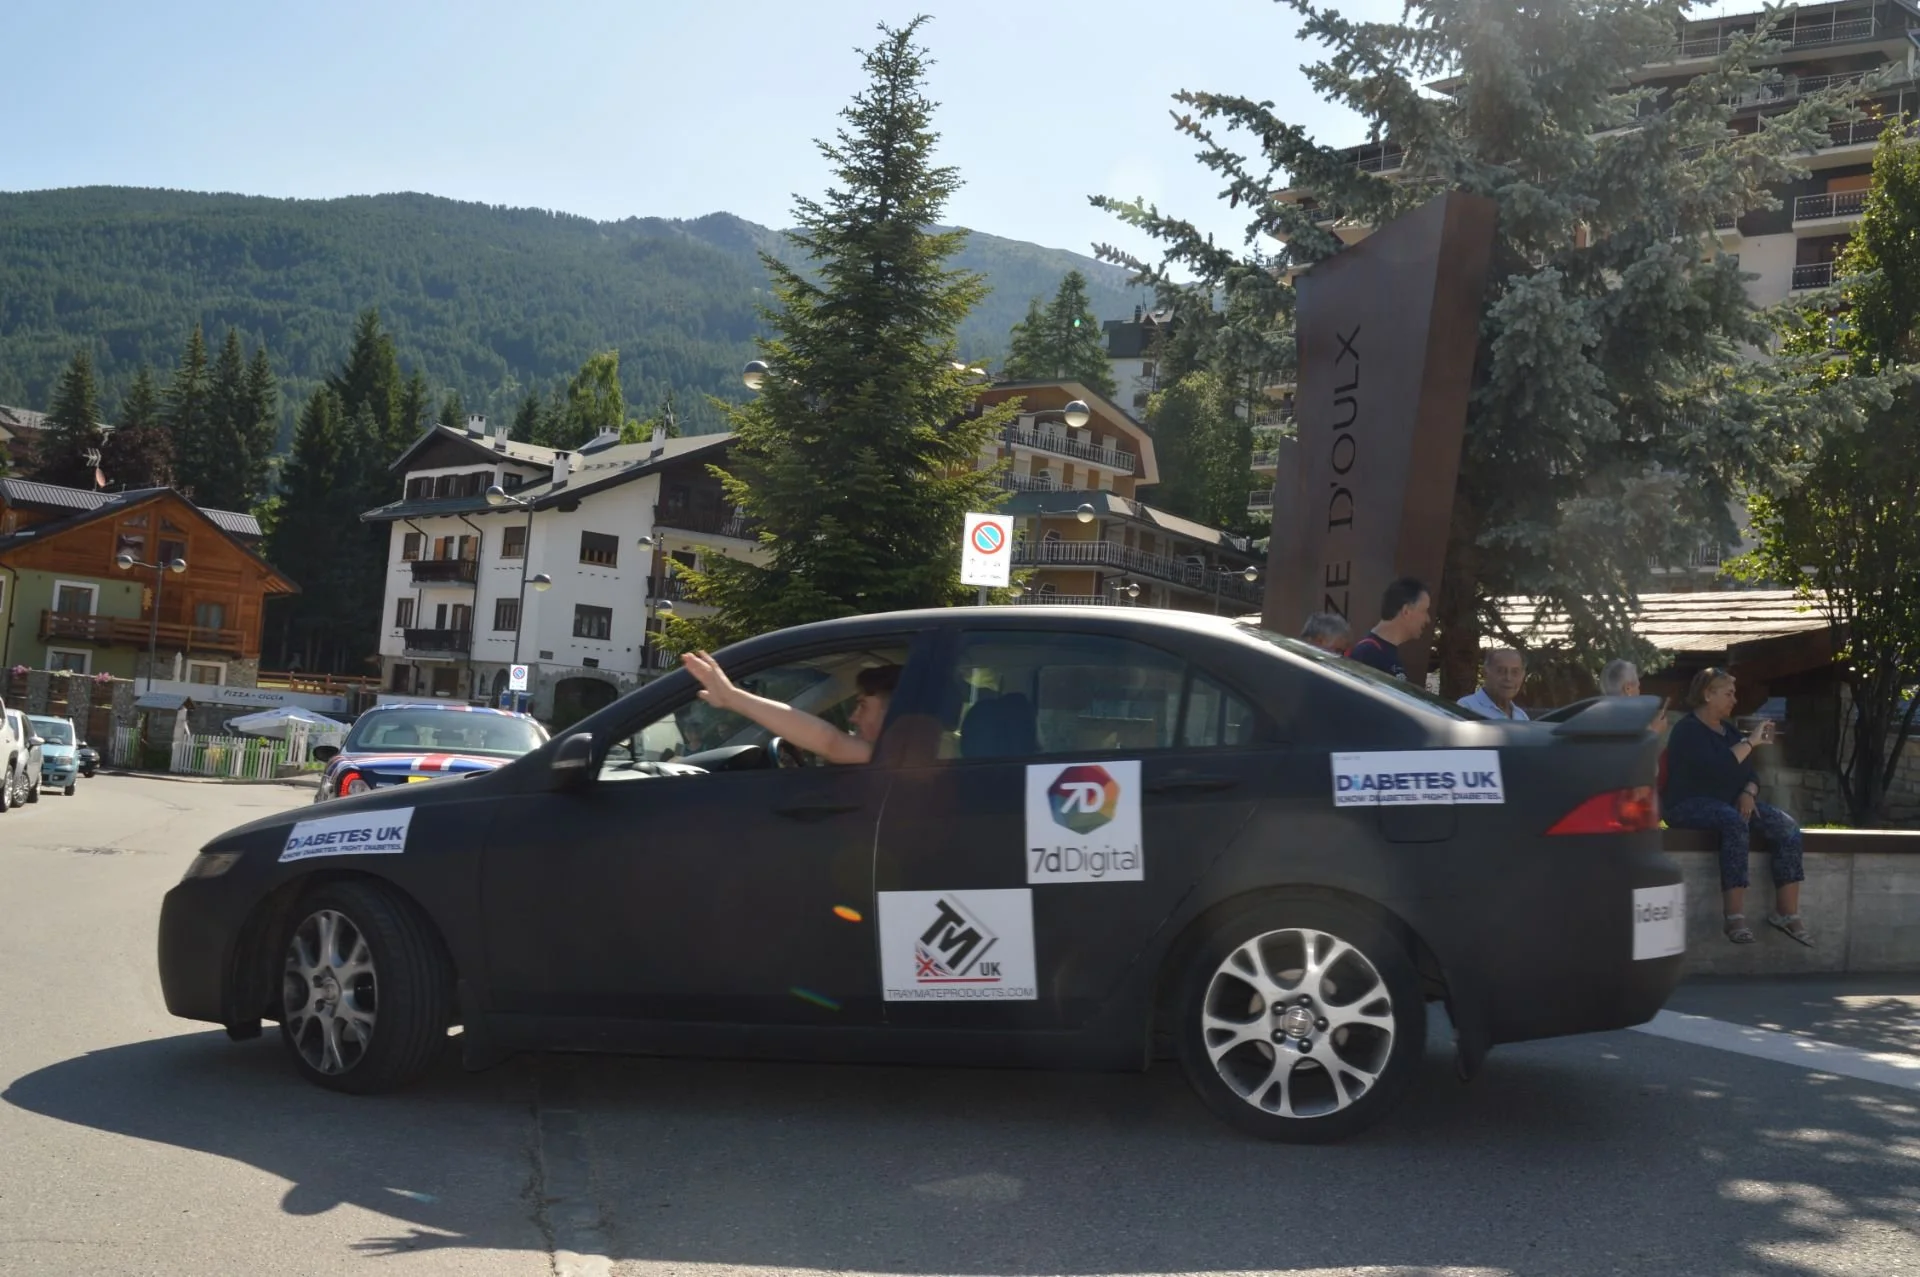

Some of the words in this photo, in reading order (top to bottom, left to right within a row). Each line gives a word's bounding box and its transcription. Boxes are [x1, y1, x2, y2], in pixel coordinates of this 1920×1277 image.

[1328, 324, 1361, 533] D'OULX
[223, 689, 250, 698] PIZZA
[1462, 771, 1497, 788] UK
[1060, 782, 1105, 814] 7D
[376, 826, 404, 841] UK
[1636, 901, 1673, 923] ideal
[979, 962, 1002, 976] UK
[887, 987, 1034, 999] TRAYMATEPRODUCTS.COM
